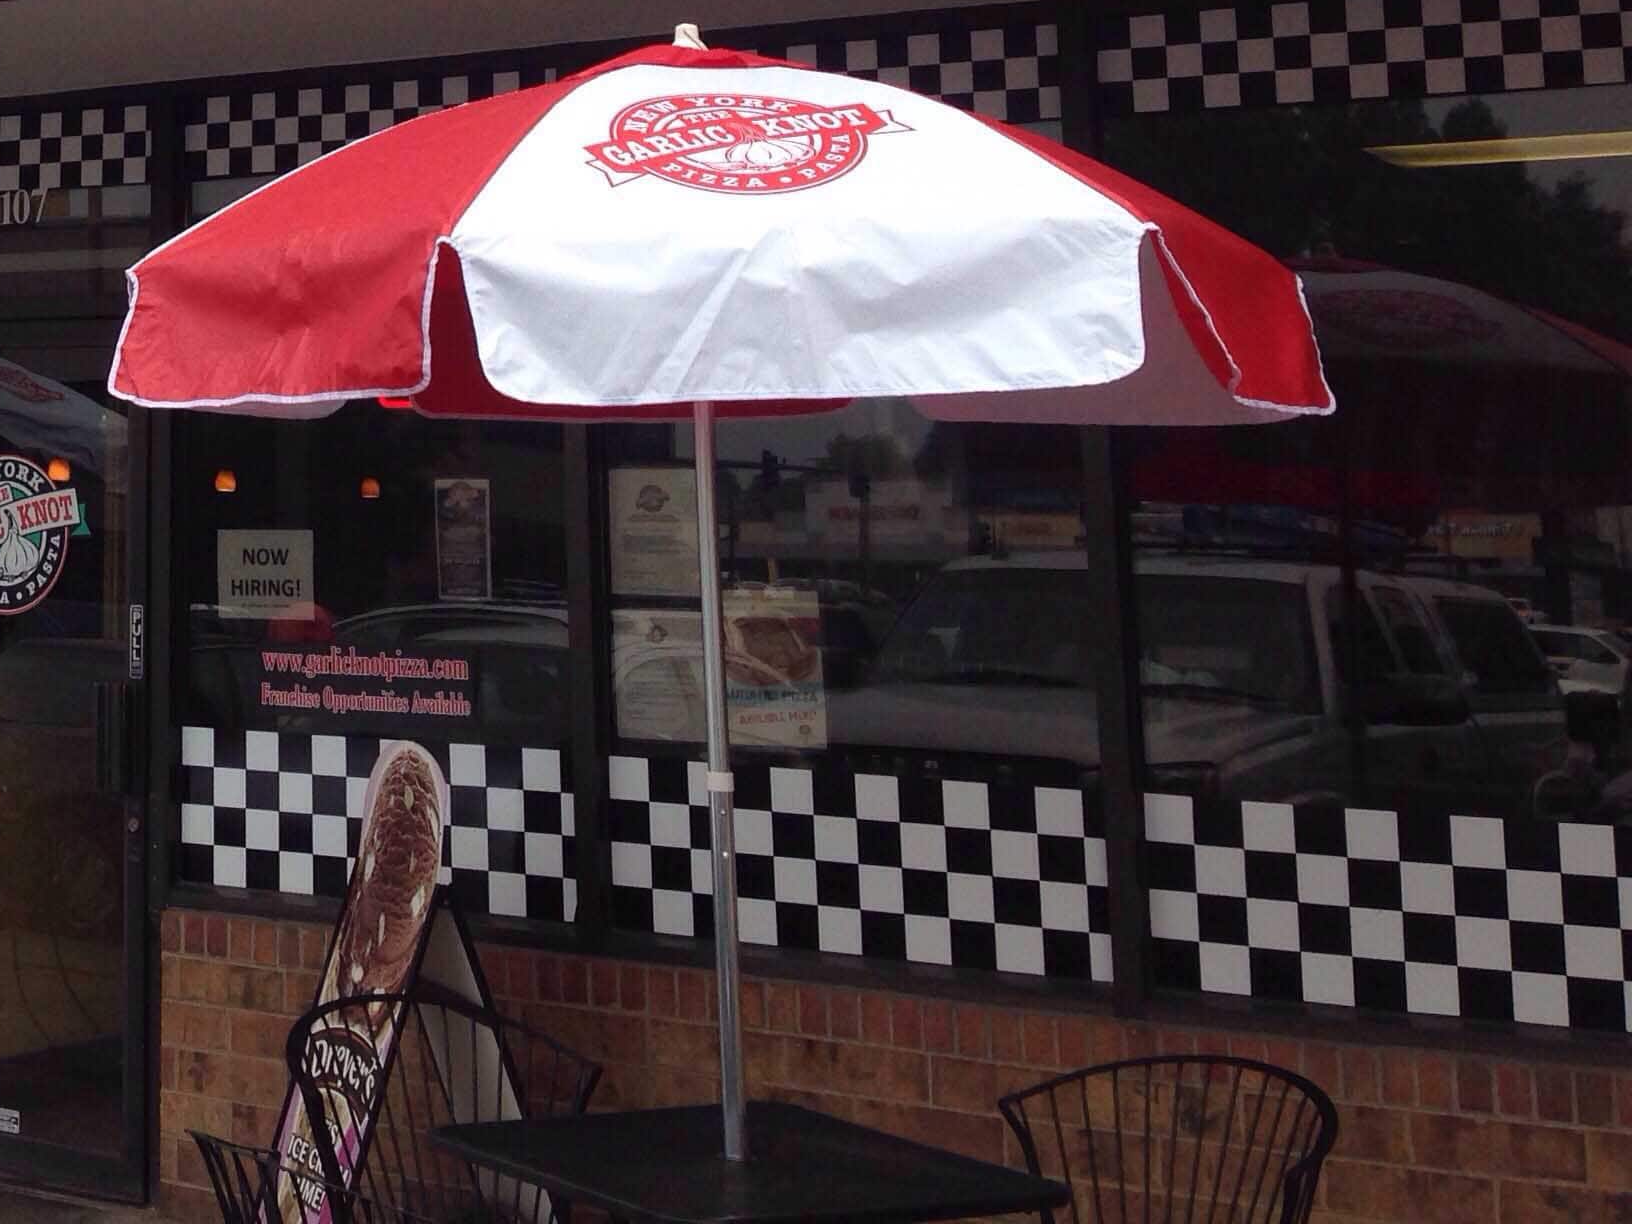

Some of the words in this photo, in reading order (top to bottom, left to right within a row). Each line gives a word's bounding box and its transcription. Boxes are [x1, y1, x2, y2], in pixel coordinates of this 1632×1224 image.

[623, 99, 674, 134] NEW
[689, 96, 799, 113] YORK
[684, 110, 733, 126] THE
[602, 125, 735, 166] GARLIC
[752, 108, 868, 137] KNOT
[662, 163, 767, 188] PIZZA
[798, 134, 851, 179] PASTA
[0, 188, 48, 225] 107
[16, 495, 73, 531] KNOT
[25, 533, 61, 596] PASTA
[242, 547, 289, 566] NOW
[231, 579, 301, 597] HIRING!
[132, 611, 141, 661] PULL
[261, 646, 469, 682] www.garlicknotpizza.com
[261, 681, 321, 708] Franchise
[322, 685, 409, 714] Opportunities
[411, 690, 471, 716] Available
[287, 1135, 307, 1163] ICE
[296, 1176, 327, 1212] IME!
